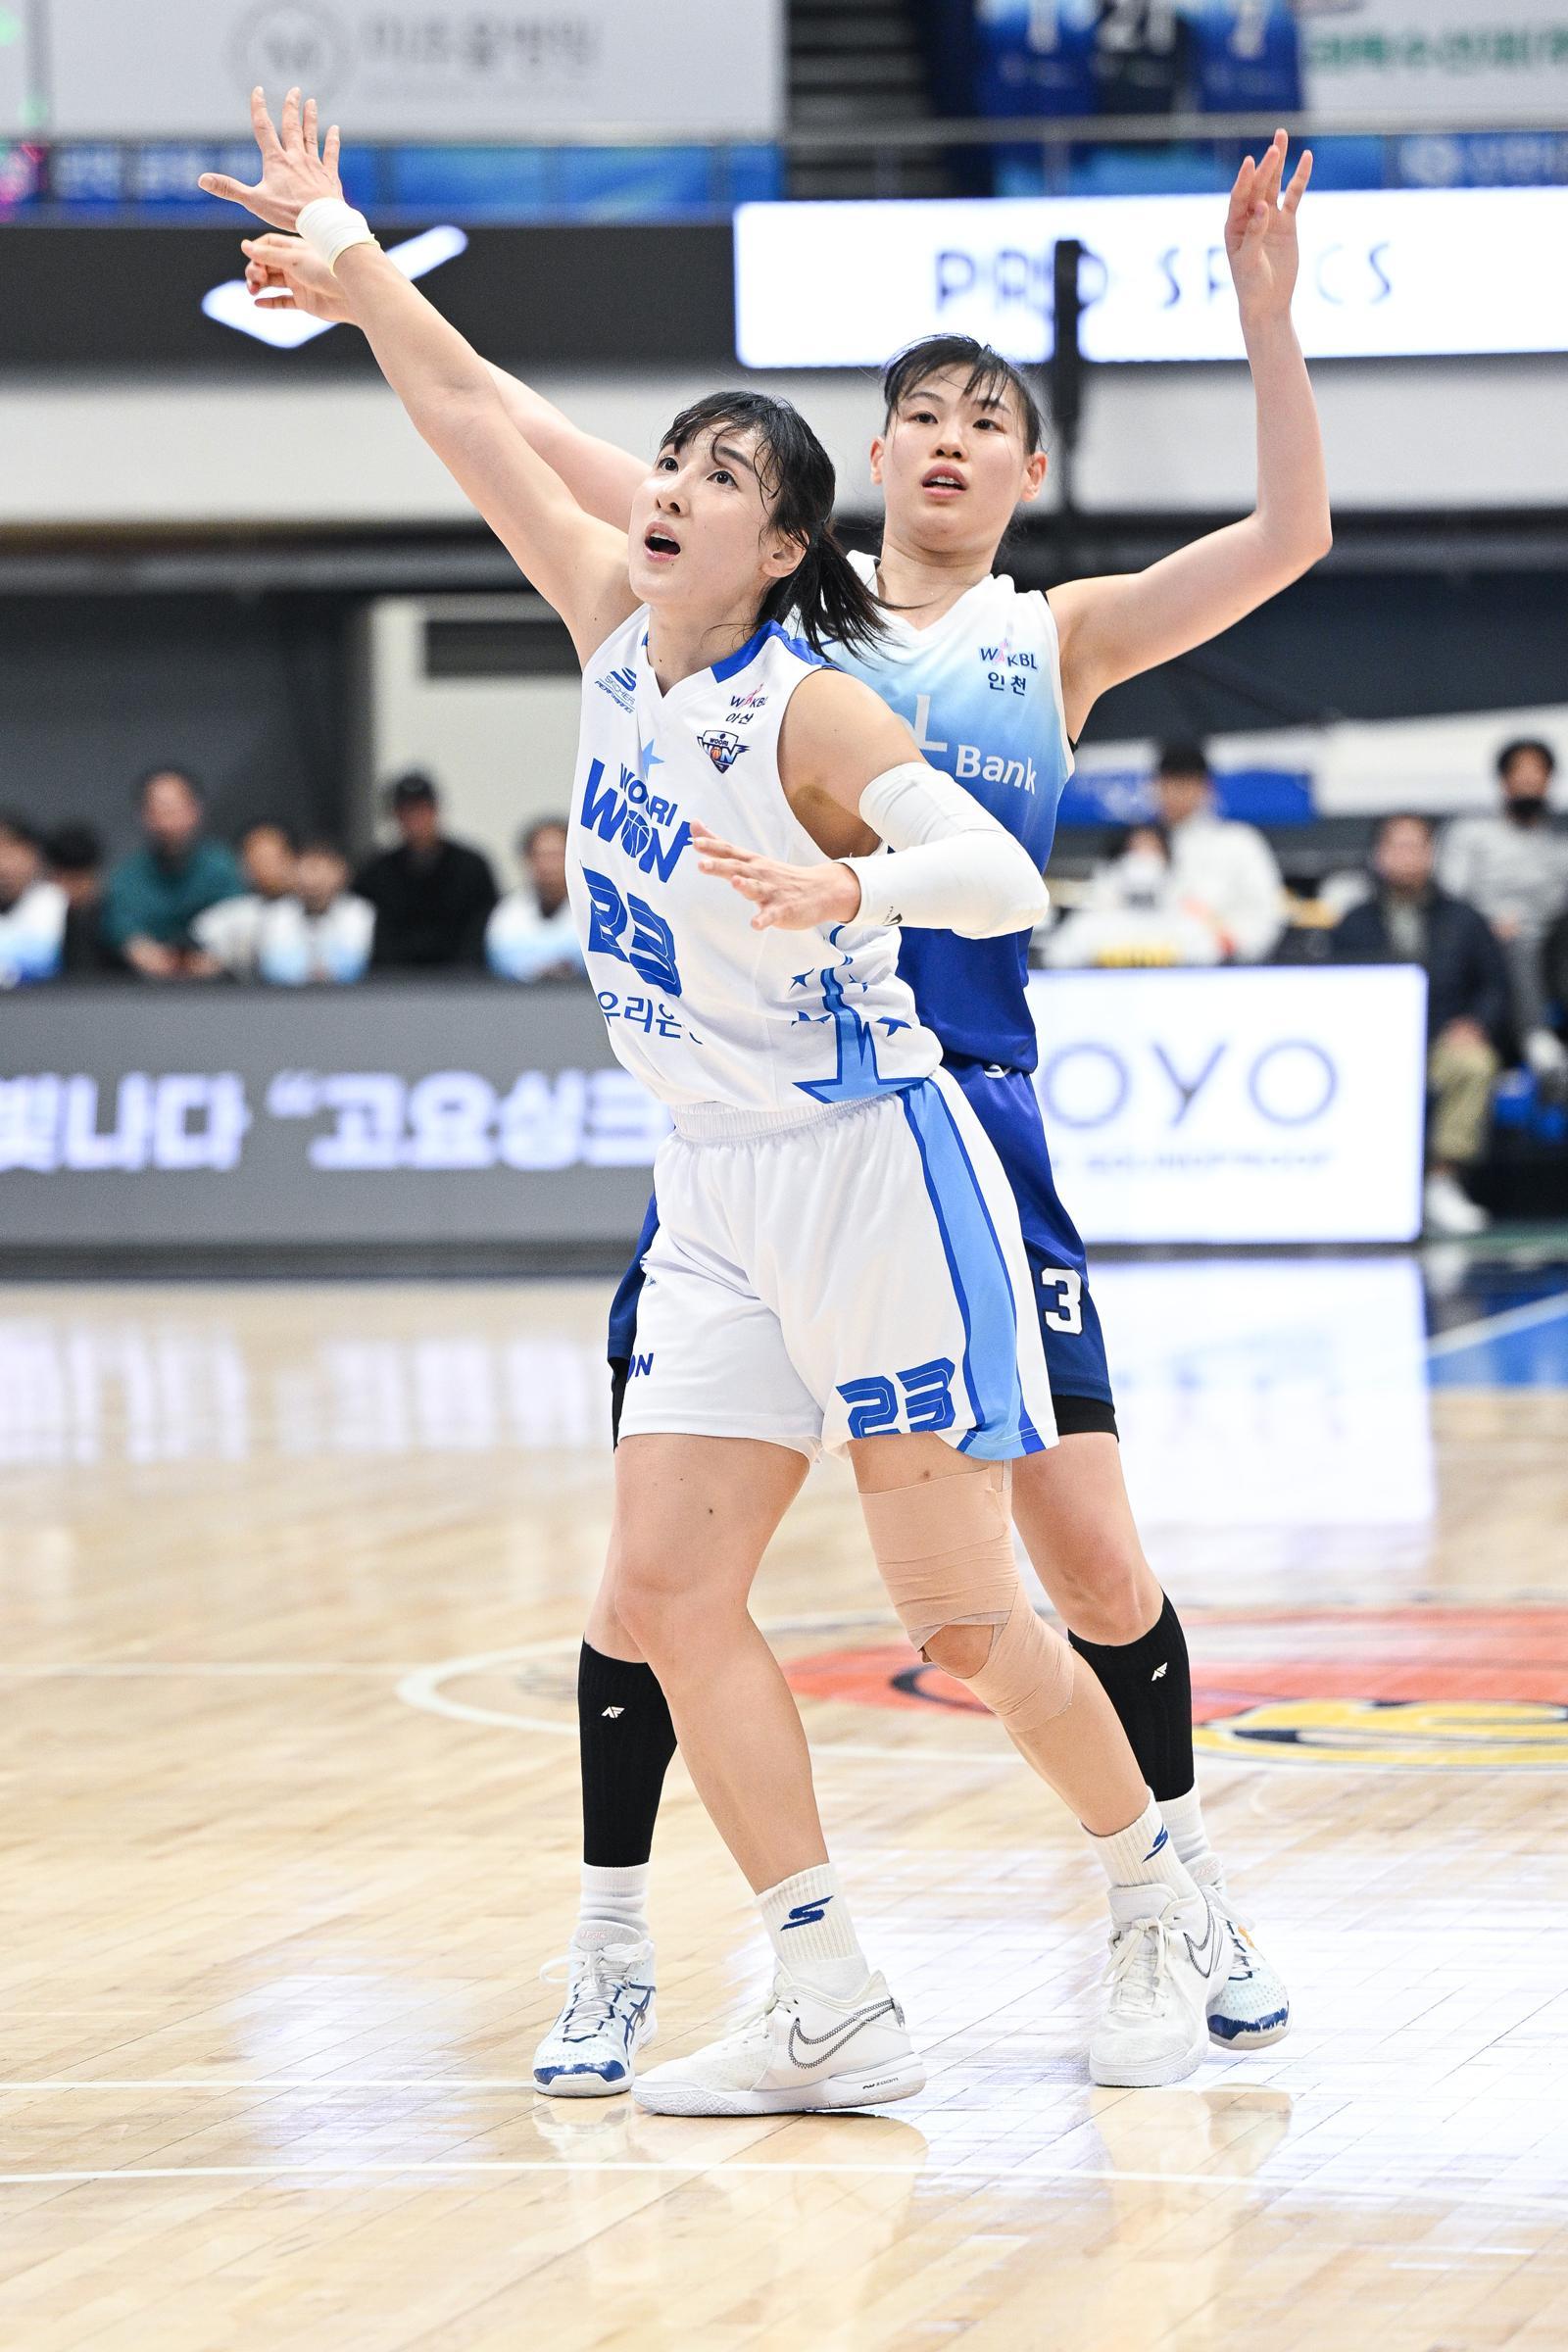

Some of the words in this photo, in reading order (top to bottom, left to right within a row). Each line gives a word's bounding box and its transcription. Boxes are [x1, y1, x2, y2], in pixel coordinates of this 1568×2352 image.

[1156, 241, 1392, 311] SPCS
[987, 671, 1027, 697] 인천
[725, 712, 755, 725] 아산
[955, 744, 1038, 795] Bank
[580, 860, 683, 999] 23
[597, 991, 704, 1046] 우리은
[1041, 1267, 1083, 1336] 3
[835, 1357, 956, 1439] 23
